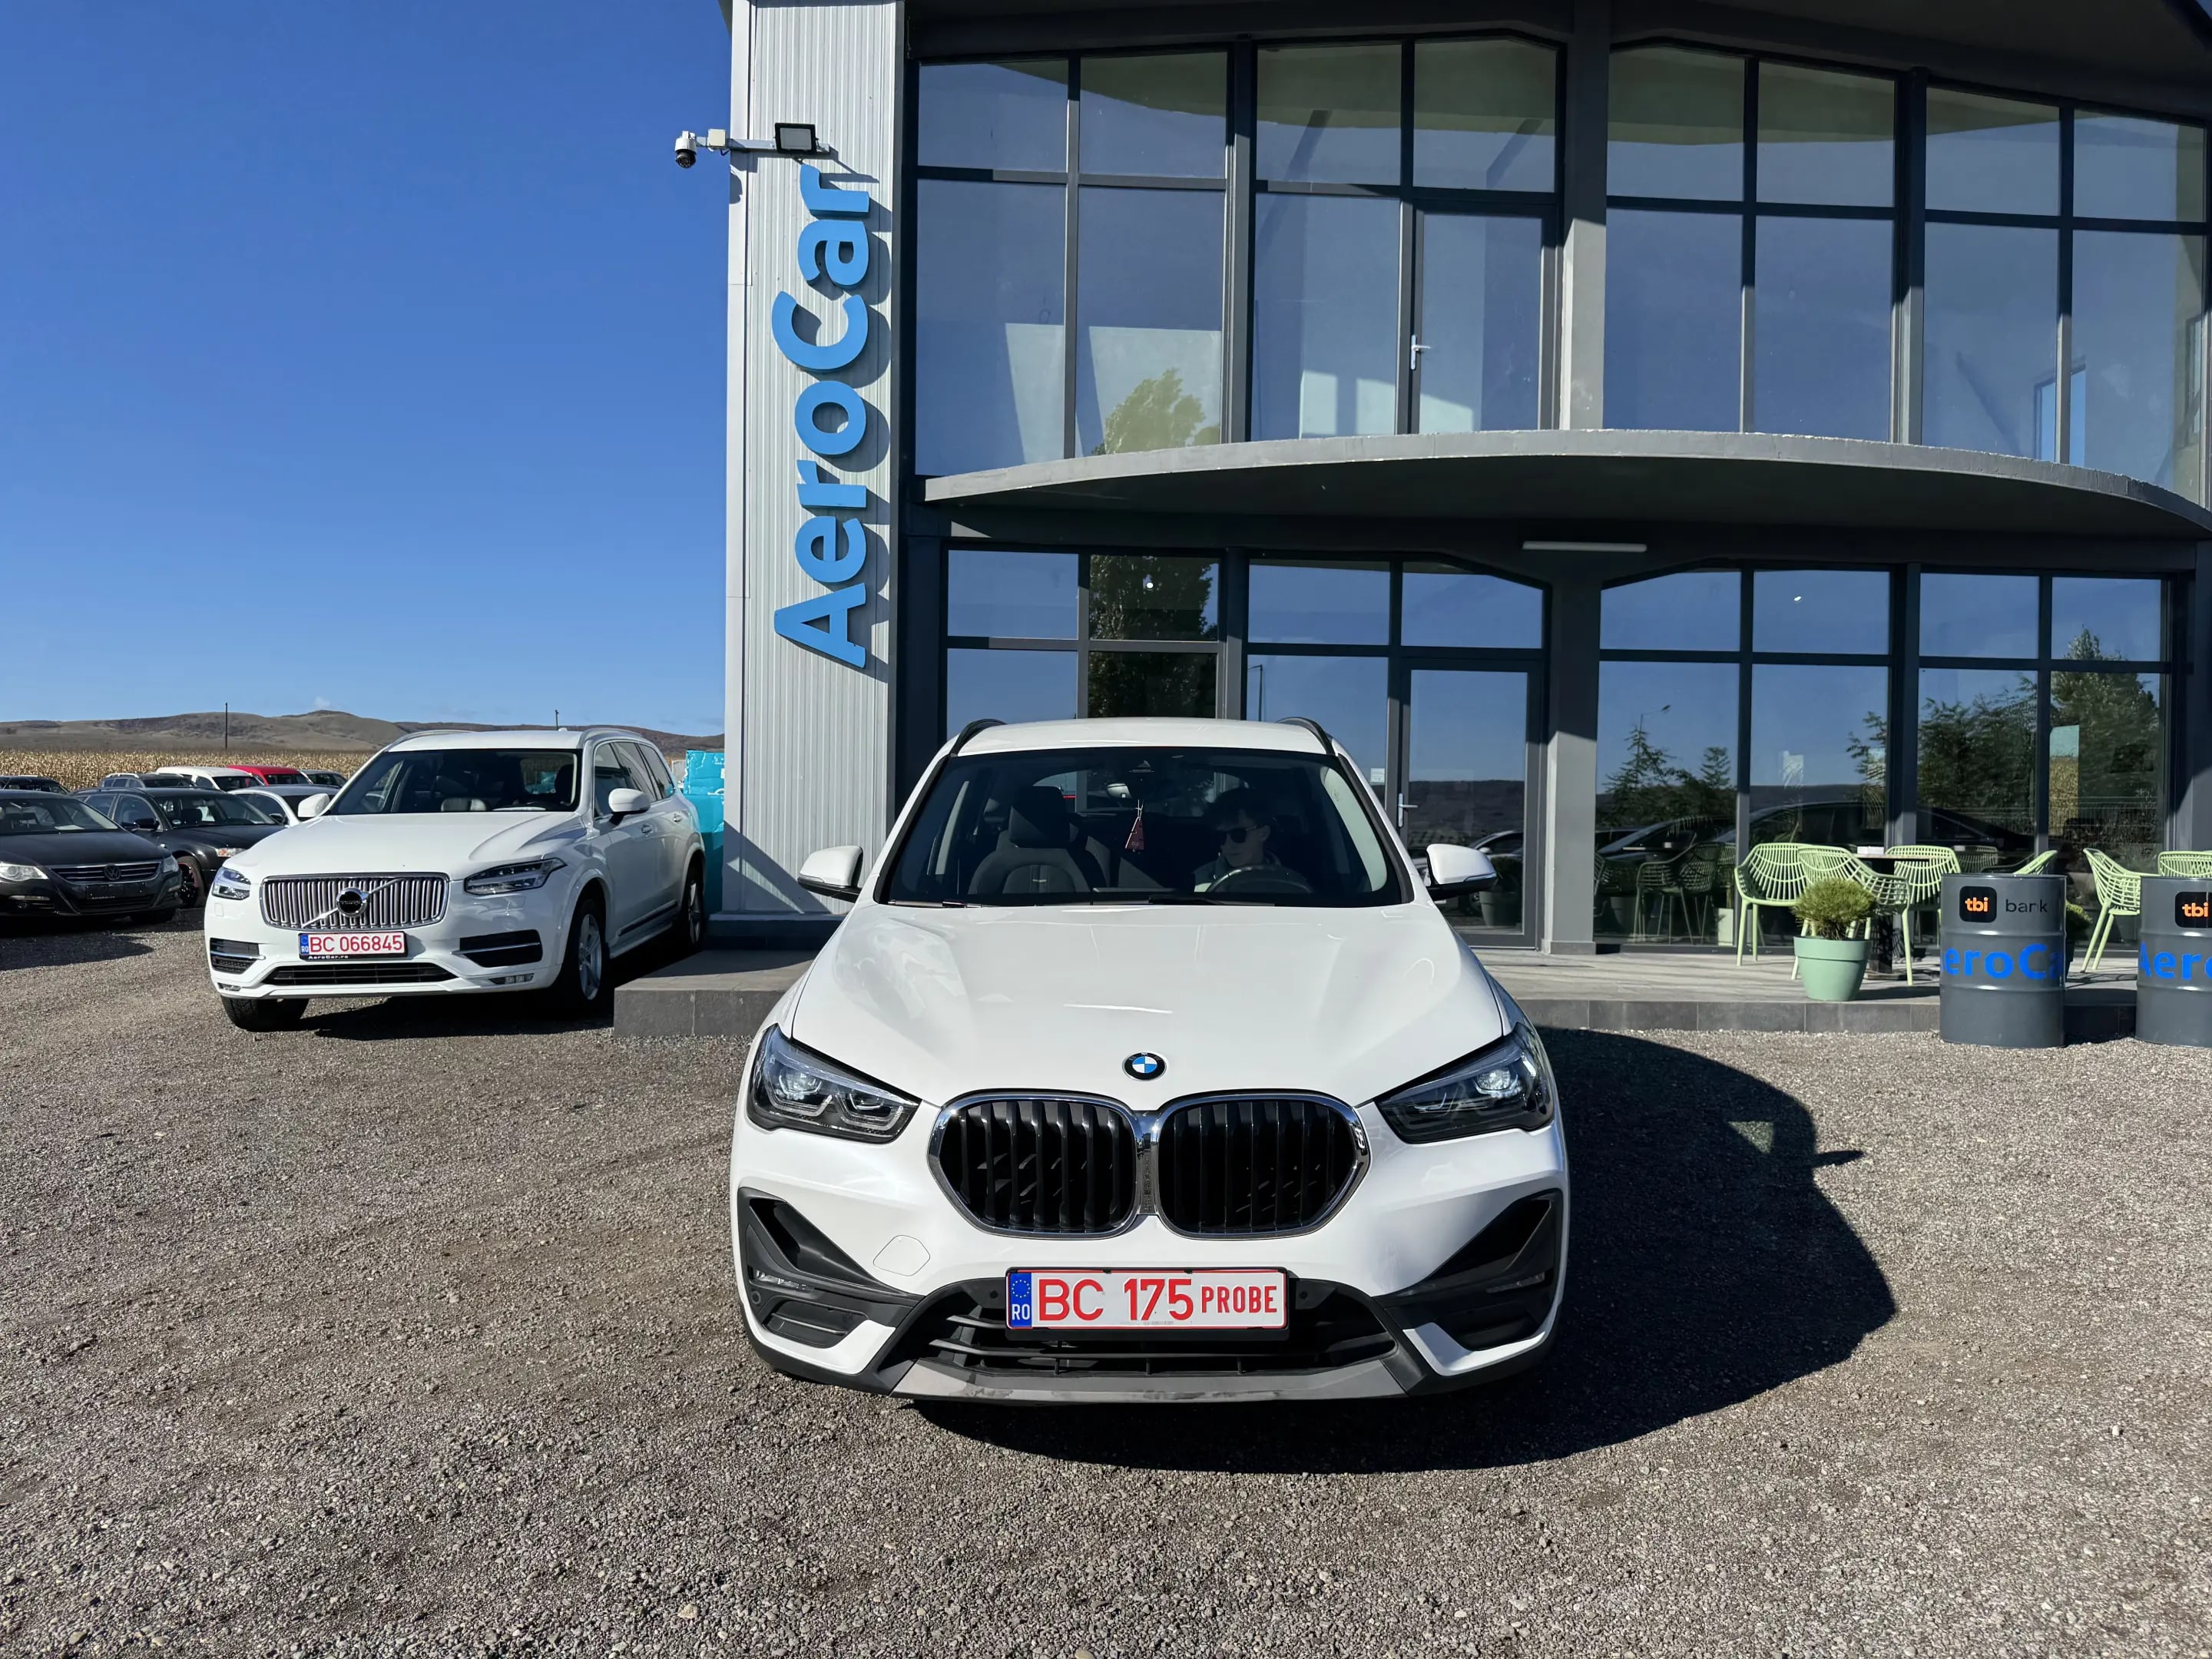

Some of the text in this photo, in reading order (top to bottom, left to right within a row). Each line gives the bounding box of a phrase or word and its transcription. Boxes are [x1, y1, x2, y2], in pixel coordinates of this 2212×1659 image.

[771, 163, 870, 669] AeroCar
[1965, 896, 2048, 912] tbi bank
[2182, 902, 2209, 918] tbi
[310, 936, 335, 953] BC
[339, 935, 402, 952] 066845
[2139, 941, 2212, 981] Aer
[1012, 1278, 1278, 1321] RO BC 175 PROBE
